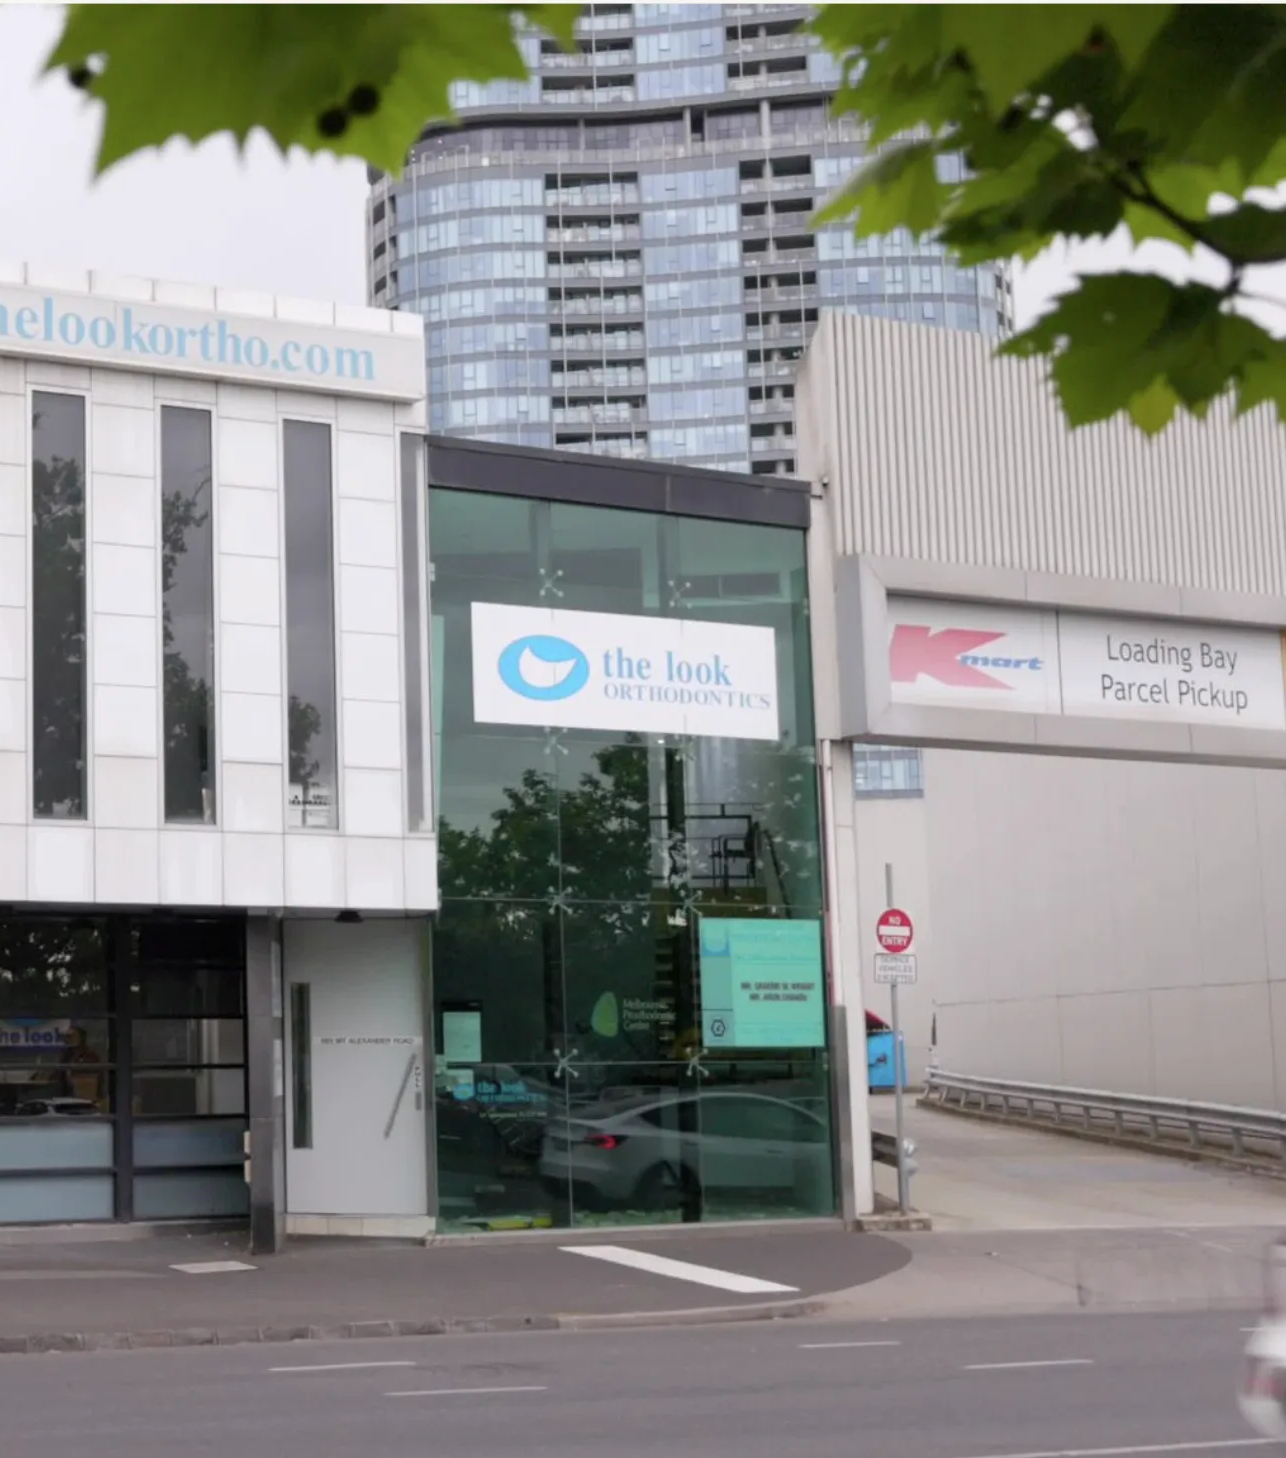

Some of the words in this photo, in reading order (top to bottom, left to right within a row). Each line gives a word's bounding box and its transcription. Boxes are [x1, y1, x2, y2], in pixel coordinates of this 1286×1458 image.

[602, 647, 652, 681] the
[666, 651, 733, 687] look
[890, 624, 1044, 691] Kmart
[1106, 634, 1193, 673] Loading
[1200, 642, 1238, 676] Bay
[604, 683, 772, 711] ORTHODONTICS
[1101, 673, 1170, 704] Parcel
[1178, 680, 1249, 715] Pickup
[889, 916, 901, 925] NO
[882, 937, 908, 946] ENTRY
